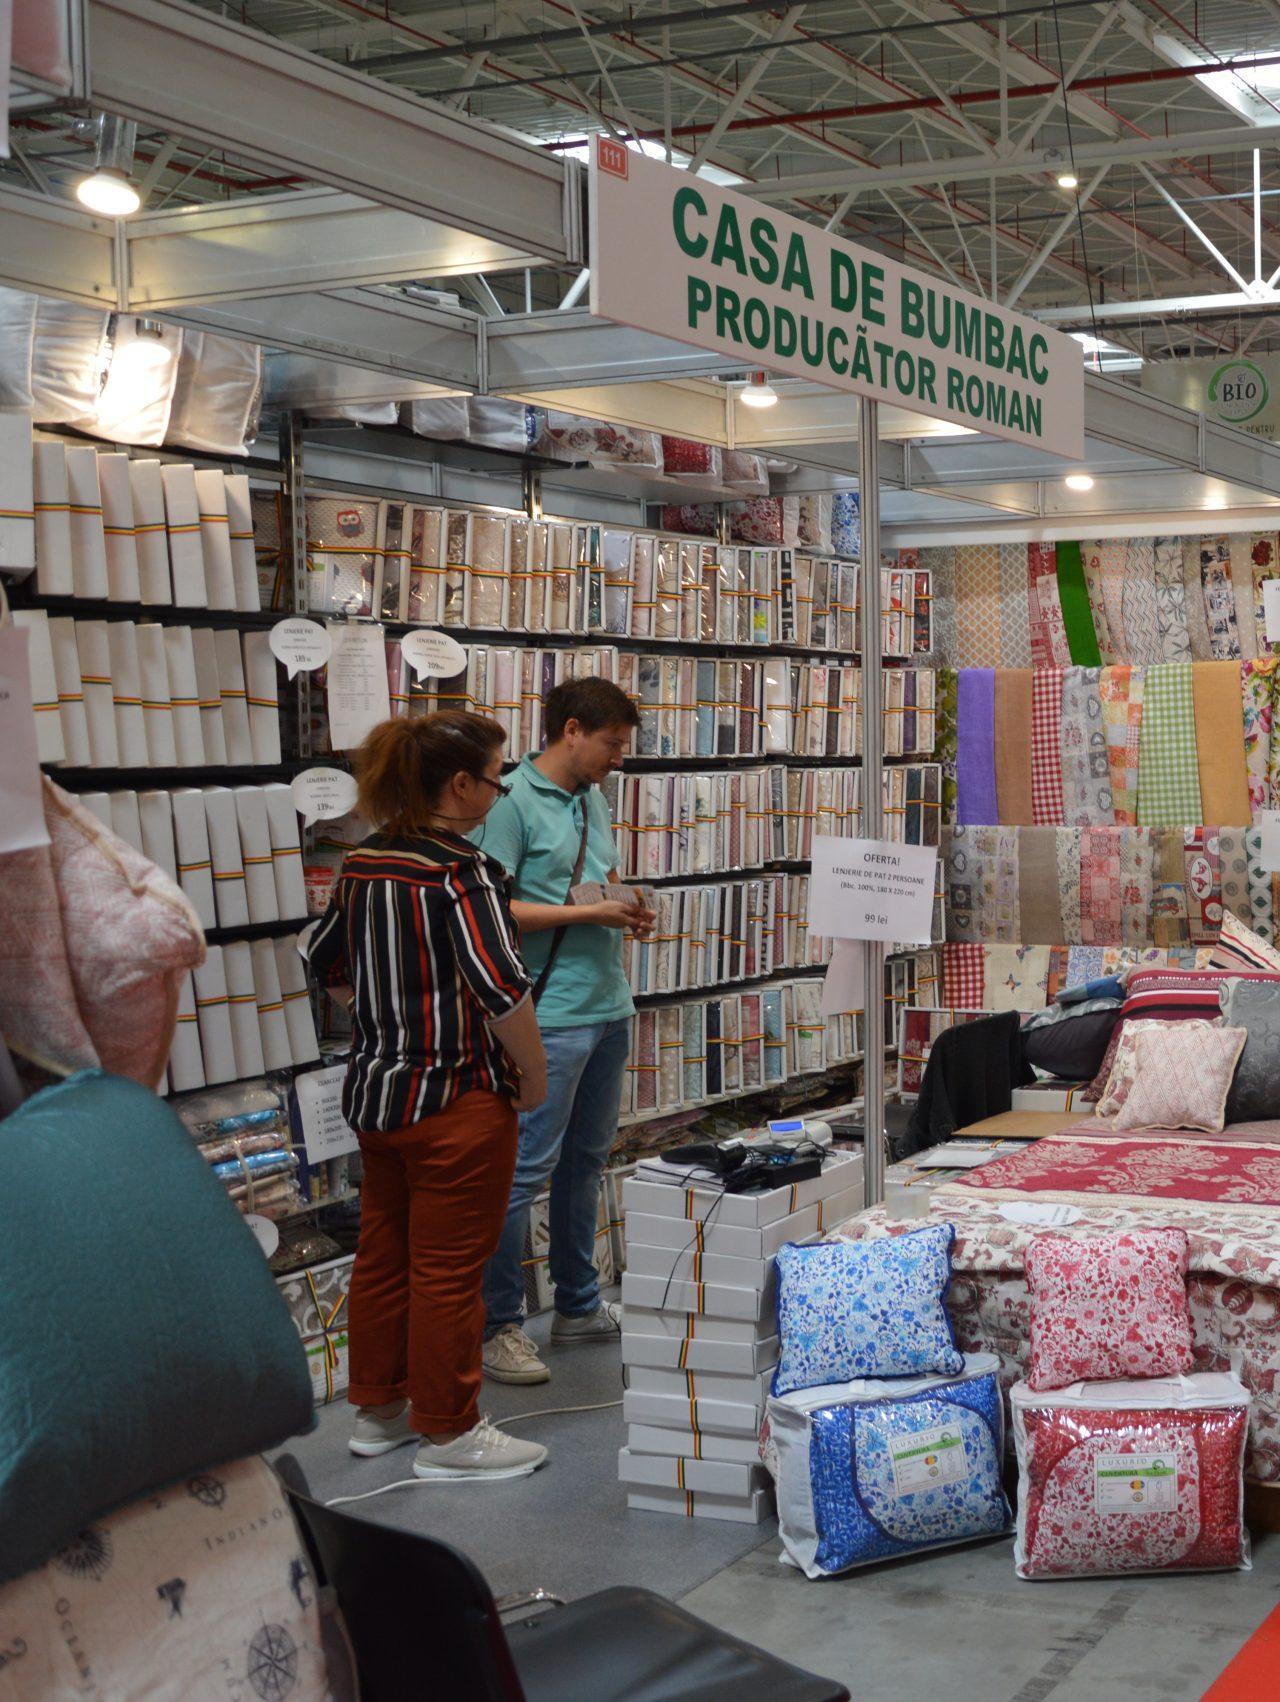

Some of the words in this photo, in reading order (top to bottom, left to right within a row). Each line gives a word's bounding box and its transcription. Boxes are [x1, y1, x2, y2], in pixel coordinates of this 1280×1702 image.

[602, 146, 621, 169] 111
[672, 186, 814, 301] CASA
[830, 247, 885, 326] DE
[900, 277, 1049, 386] BUMBAC
[1223, 382, 1256, 402] BIO
[947, 368, 1042, 437] ROMAN
[863, 853, 900, 866] OFERTA!
[832, 867, 862, 879] LENJERIE
[864, 870, 872, 879] DE
[874, 872, 886, 880] PAT
[887, 873, 892, 881] 2
[892, 874, 925, 885] PERSOANE
[864, 914, 876, 924] 99
[877, 914, 888, 925] lei
